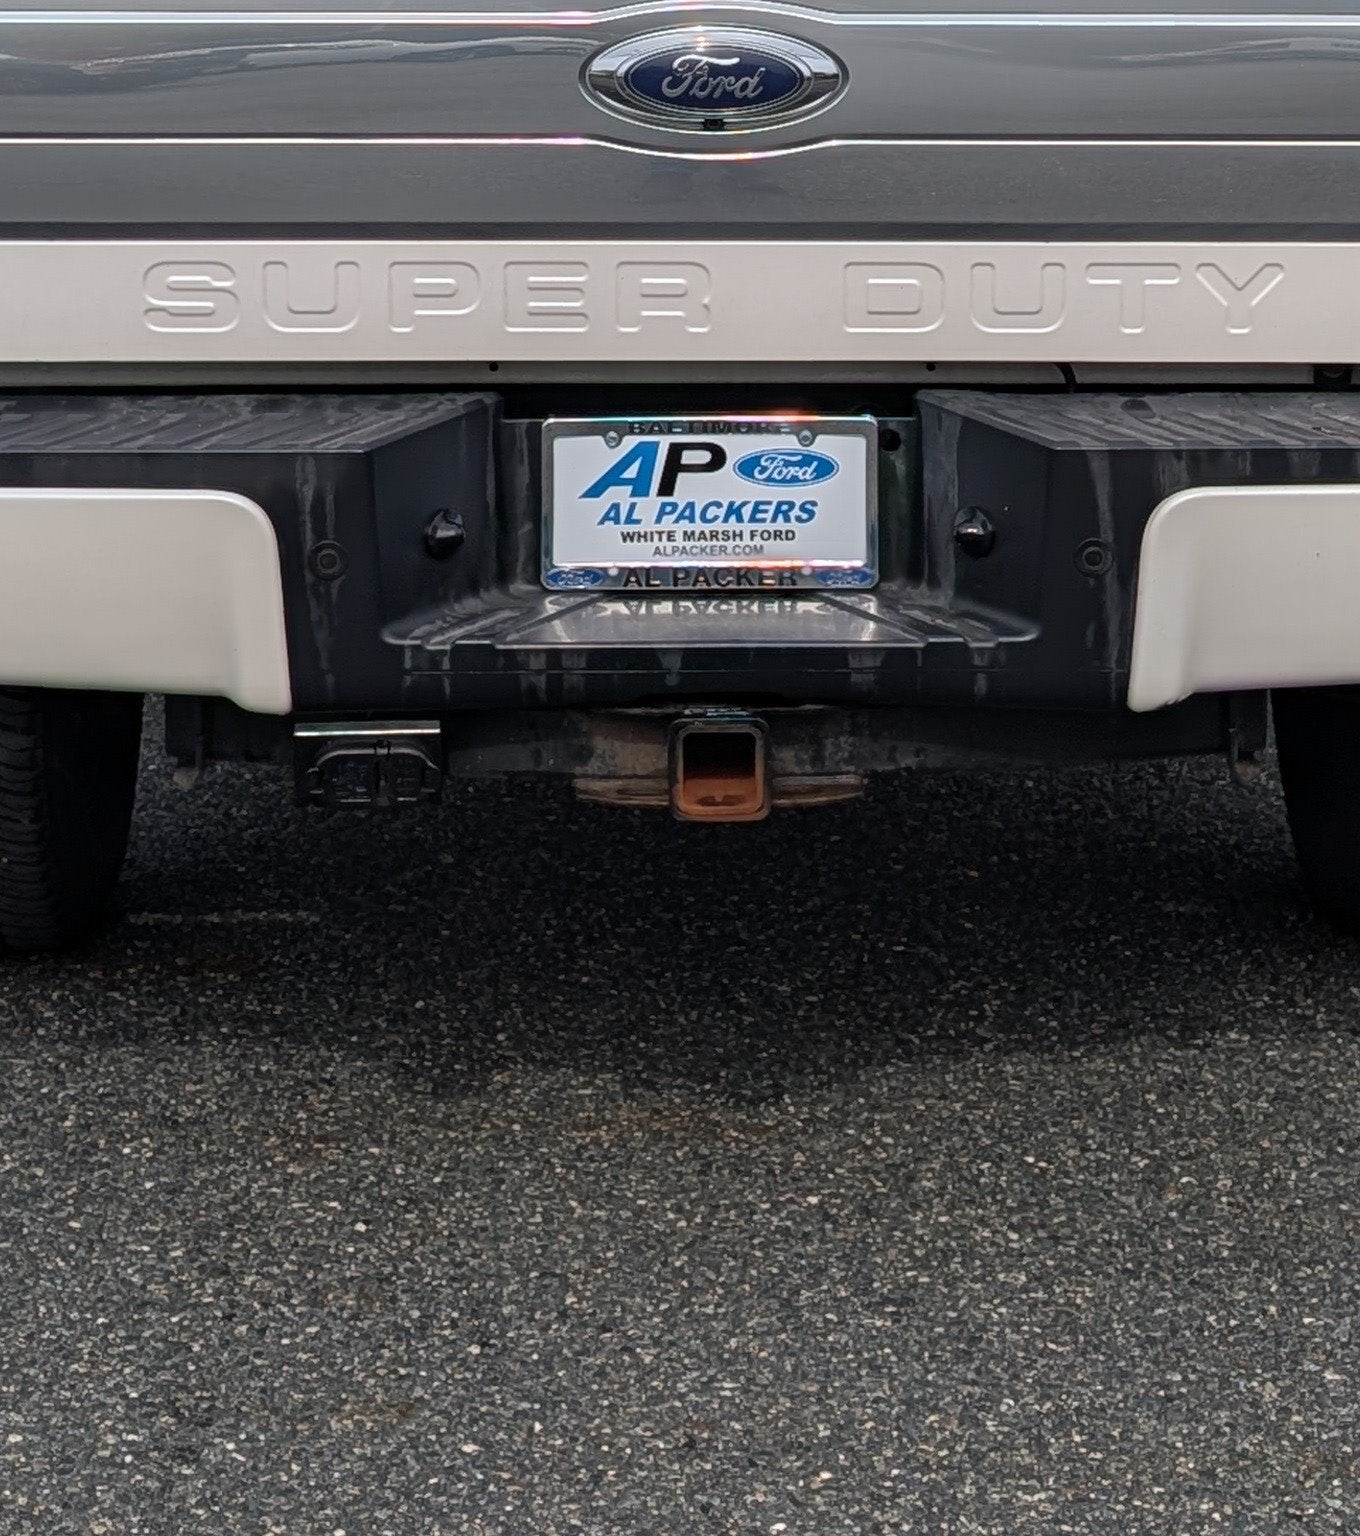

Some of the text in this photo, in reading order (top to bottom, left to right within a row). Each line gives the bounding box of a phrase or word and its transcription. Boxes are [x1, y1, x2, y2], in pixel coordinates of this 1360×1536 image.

[661, 54, 766, 99] Ford
[142, 262, 1286, 335] SUPER DUTY
[577, 439, 727, 499] AP
[754, 454, 819, 481] Ford
[597, 500, 819, 526] AL PACKERS
[620, 528, 796, 543] WHITE MARSH FORD
[652, 544, 764, 557] ALPACKER.COM
[622, 567, 798, 587] AL PACKER
